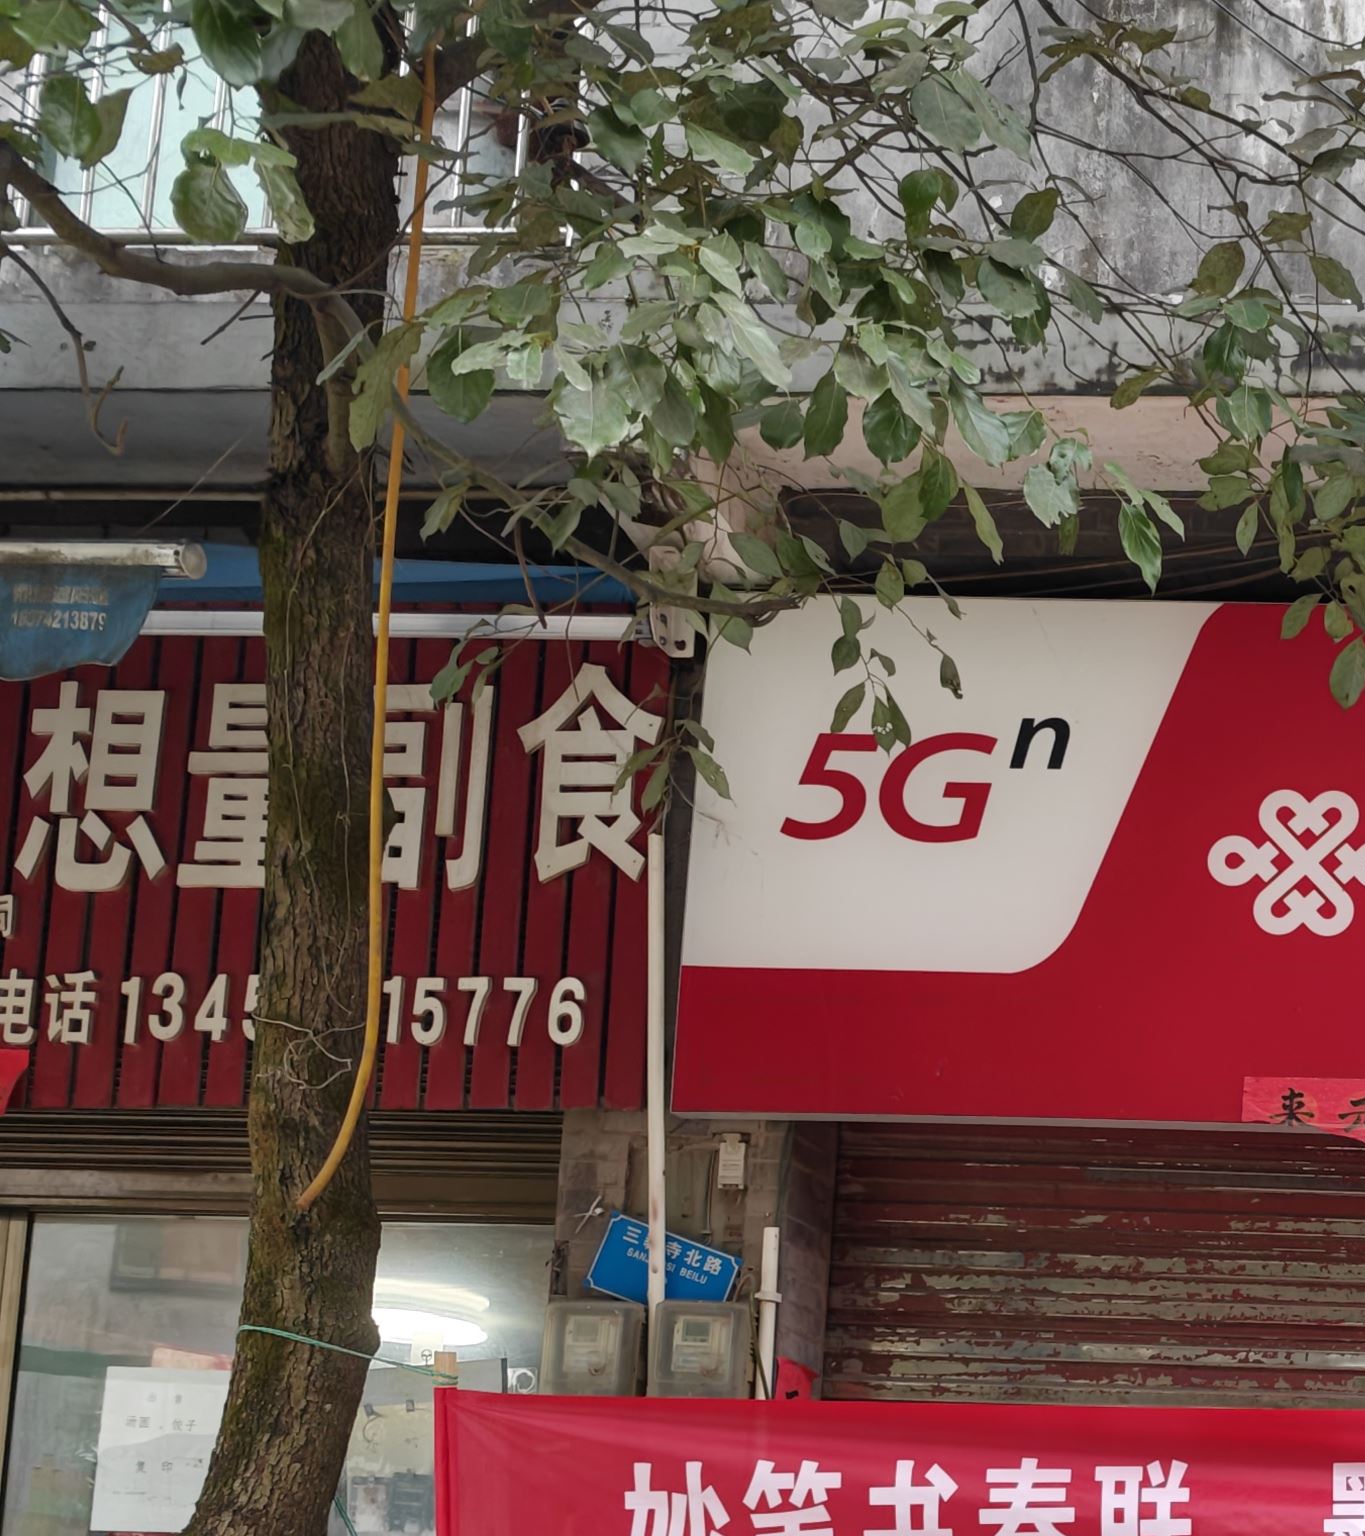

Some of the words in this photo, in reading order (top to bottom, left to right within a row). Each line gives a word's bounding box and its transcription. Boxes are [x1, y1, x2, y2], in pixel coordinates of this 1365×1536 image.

[0, 968, 99, 1045] 电话
[121, 972, 587, 1048] 134515776
[622, 1225, 722, 1276] 三寺北路
[680, 1267, 708, 1285] BEILU
